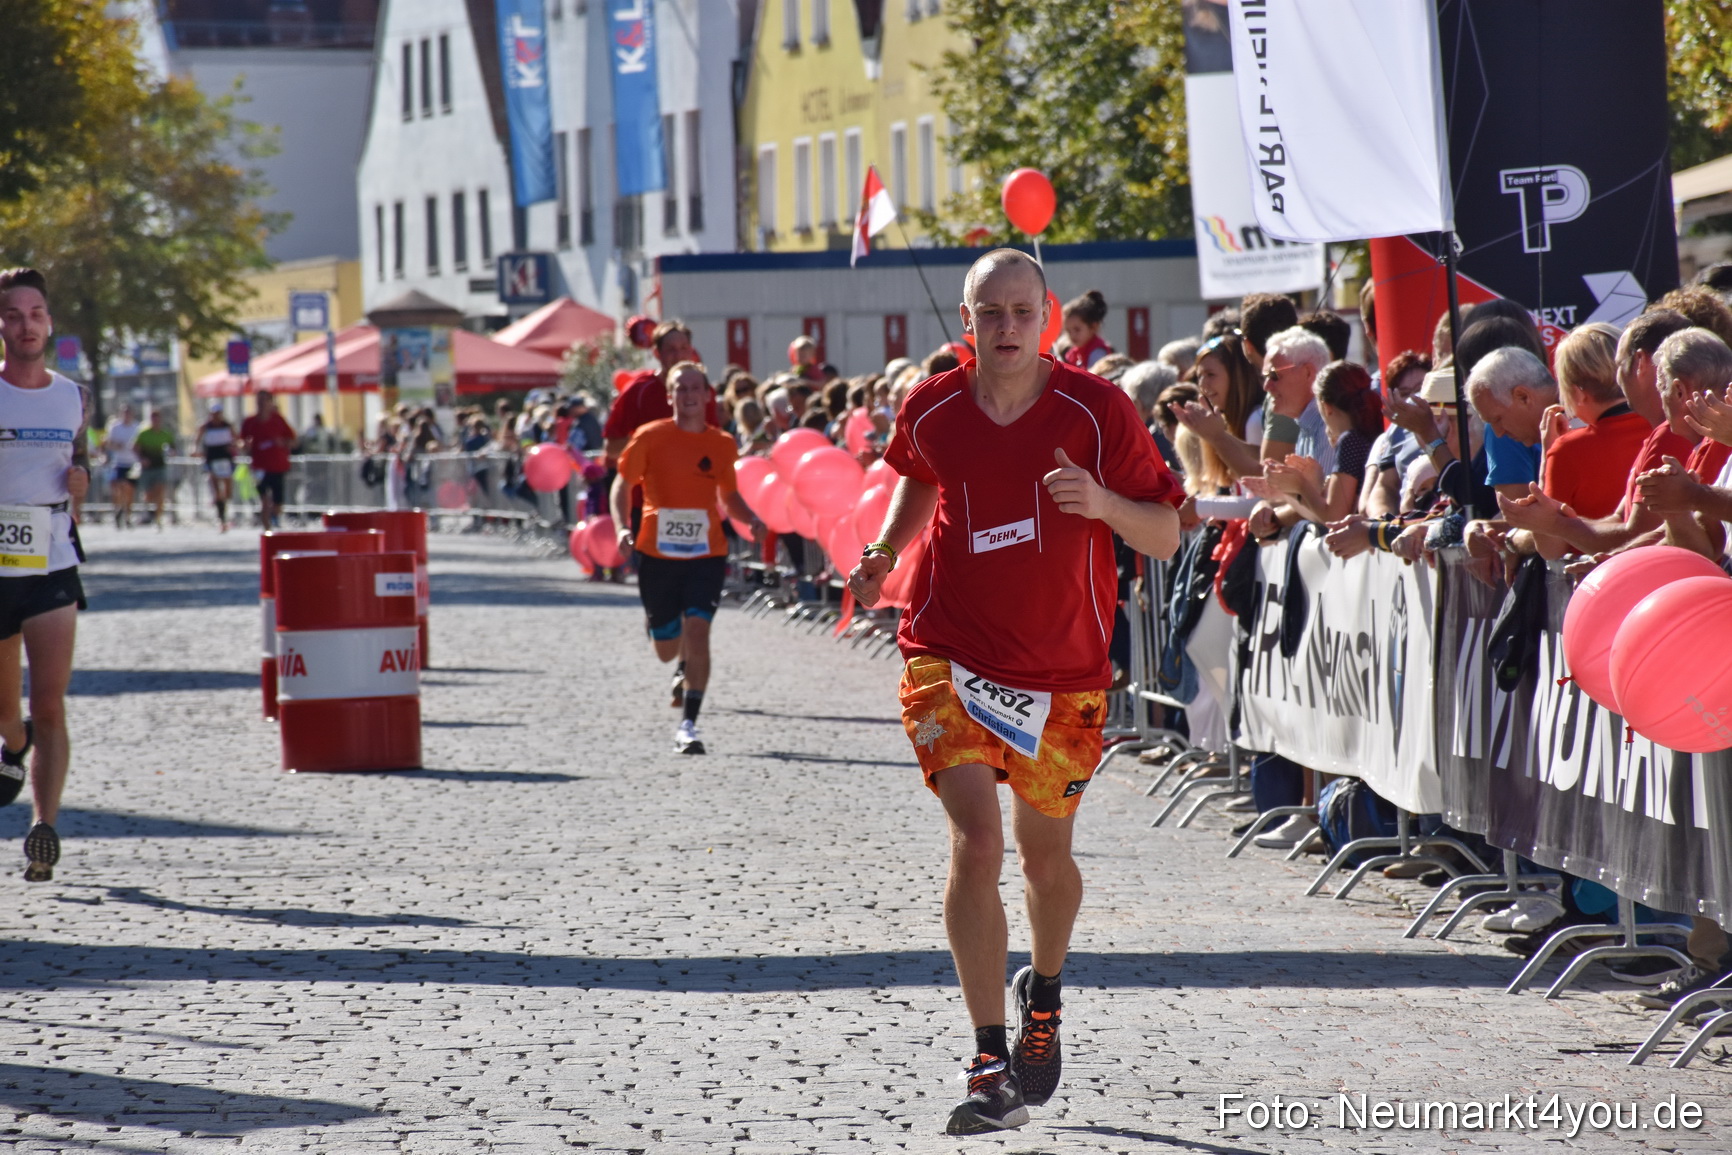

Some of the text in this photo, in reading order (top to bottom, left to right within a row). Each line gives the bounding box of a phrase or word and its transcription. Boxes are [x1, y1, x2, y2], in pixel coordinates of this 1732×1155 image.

[1506, 175, 1534, 186] Team
[665, 520, 703, 538] 2537
[988, 528, 1018, 545] DEHN
[2, 555, 20, 567] Eric
[963, 674, 1035, 718] 2452
[971, 704, 1016, 741] Christian
